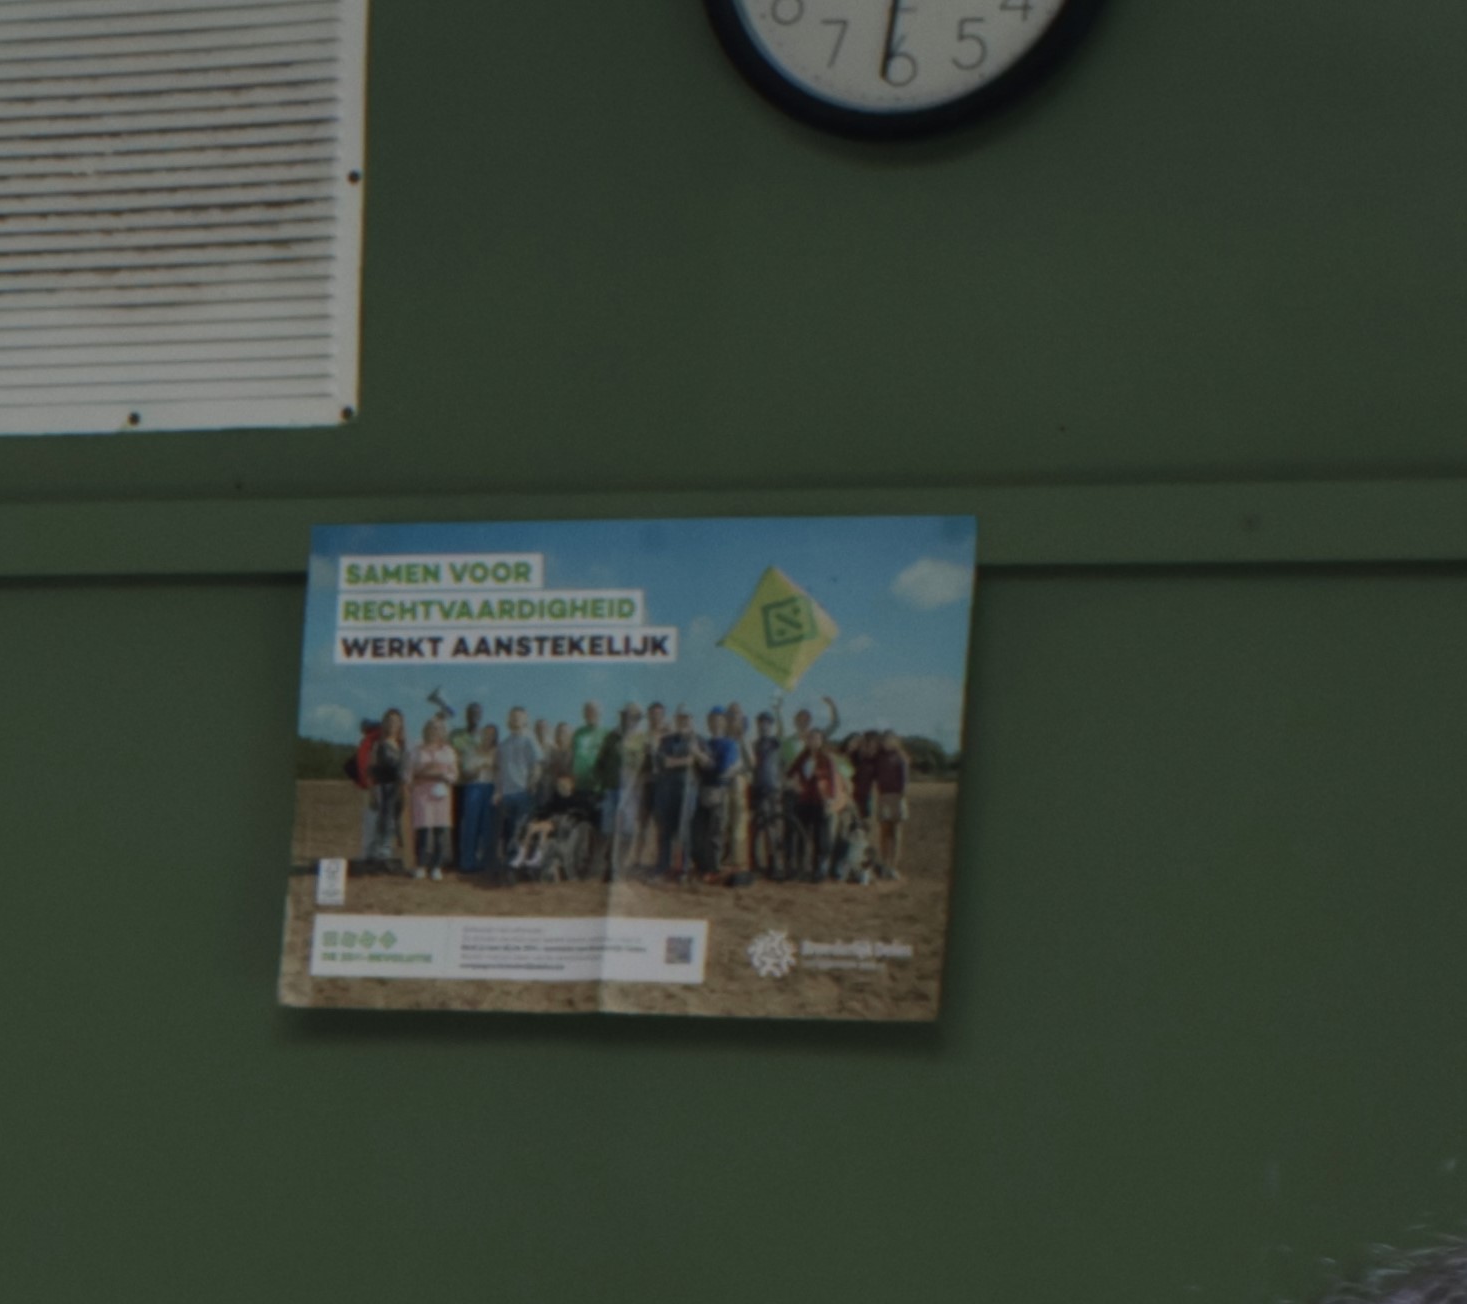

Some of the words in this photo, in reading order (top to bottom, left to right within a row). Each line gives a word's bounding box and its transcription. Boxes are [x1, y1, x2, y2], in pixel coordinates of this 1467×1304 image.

[820, 18, 849, 70] 7
[951, 16, 988, 71] 5
[343, 561, 442, 586] SAMEN
[449, 560, 533, 585] VOOR
[341, 595, 637, 624] RECHTVAARDIGHEID
[341, 635, 444, 660] WERKT
[451, 634, 671, 658] AANSTEKELIJK
